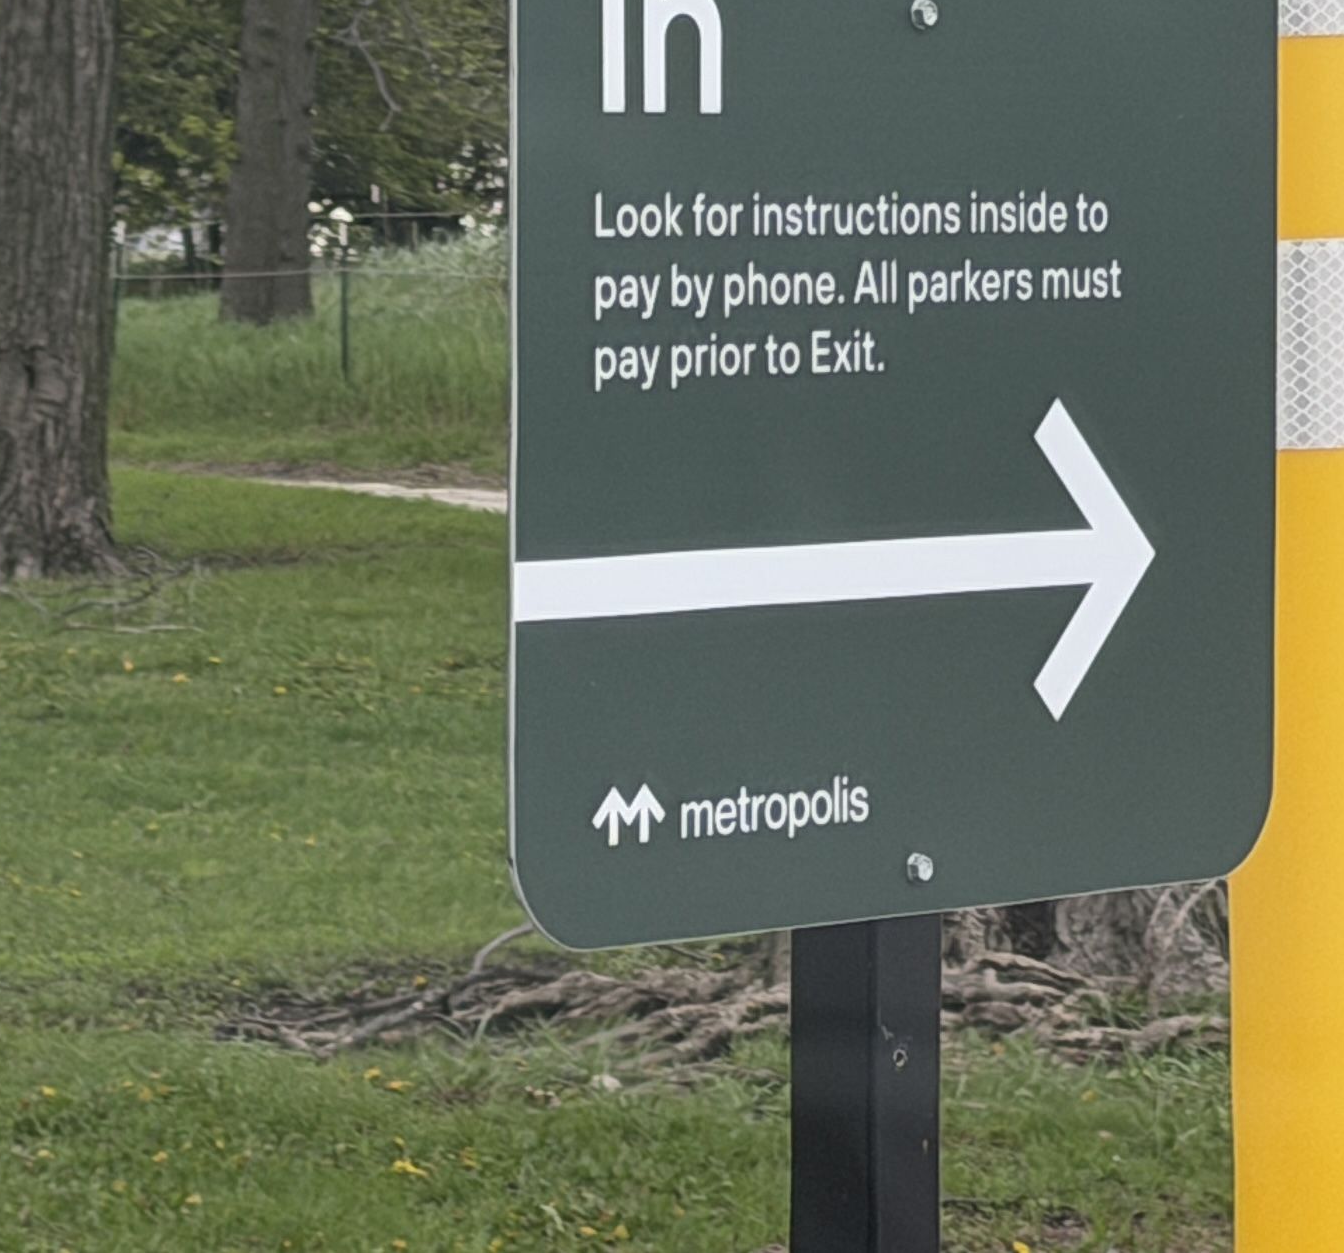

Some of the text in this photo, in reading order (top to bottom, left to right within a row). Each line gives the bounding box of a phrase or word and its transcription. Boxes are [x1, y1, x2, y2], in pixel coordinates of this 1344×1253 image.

[595, 190, 1108, 238] Look for instructions inside to
[595, 259, 1122, 321] pay by phone. All parkers must
[595, 329, 884, 392] pay prior to Exit.
[680, 775, 869, 839] metropolis
